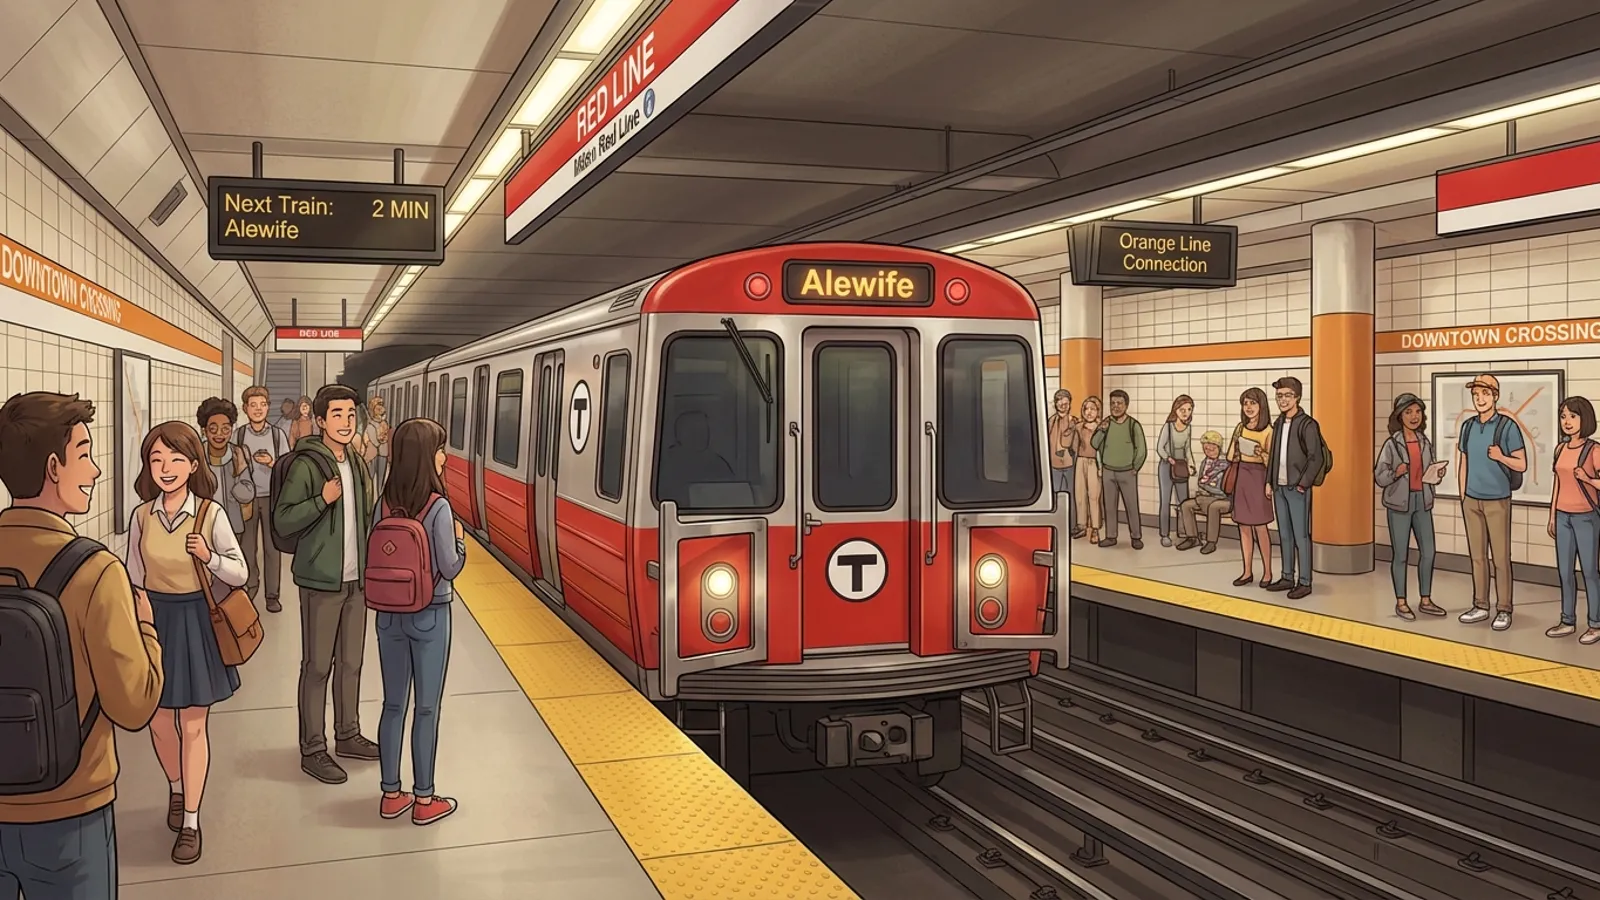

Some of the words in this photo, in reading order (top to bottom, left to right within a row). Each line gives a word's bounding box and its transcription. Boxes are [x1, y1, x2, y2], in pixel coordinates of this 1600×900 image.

[577, 84, 608, 143] RED
[613, 31, 656, 108] LINE
[225, 193, 272, 213] Next
[278, 195, 334, 216] Train:
[372, 200, 384, 218] 2
[390, 199, 430, 220] MIN
[225, 219, 300, 240] Alewife
[1119, 232, 1175, 254] Orange
[1180, 235, 1211, 252] Line
[1, 243, 77, 306] DOWNTOWN
[1123, 253, 1208, 273] Connection
[801, 268, 914, 298] Alewife
[1401, 328, 1500, 349] DOWNTOWN
[1505, 321, 1600, 344] CROSSING
[573, 398, 587, 440] T
[837, 554, 877, 592] T
